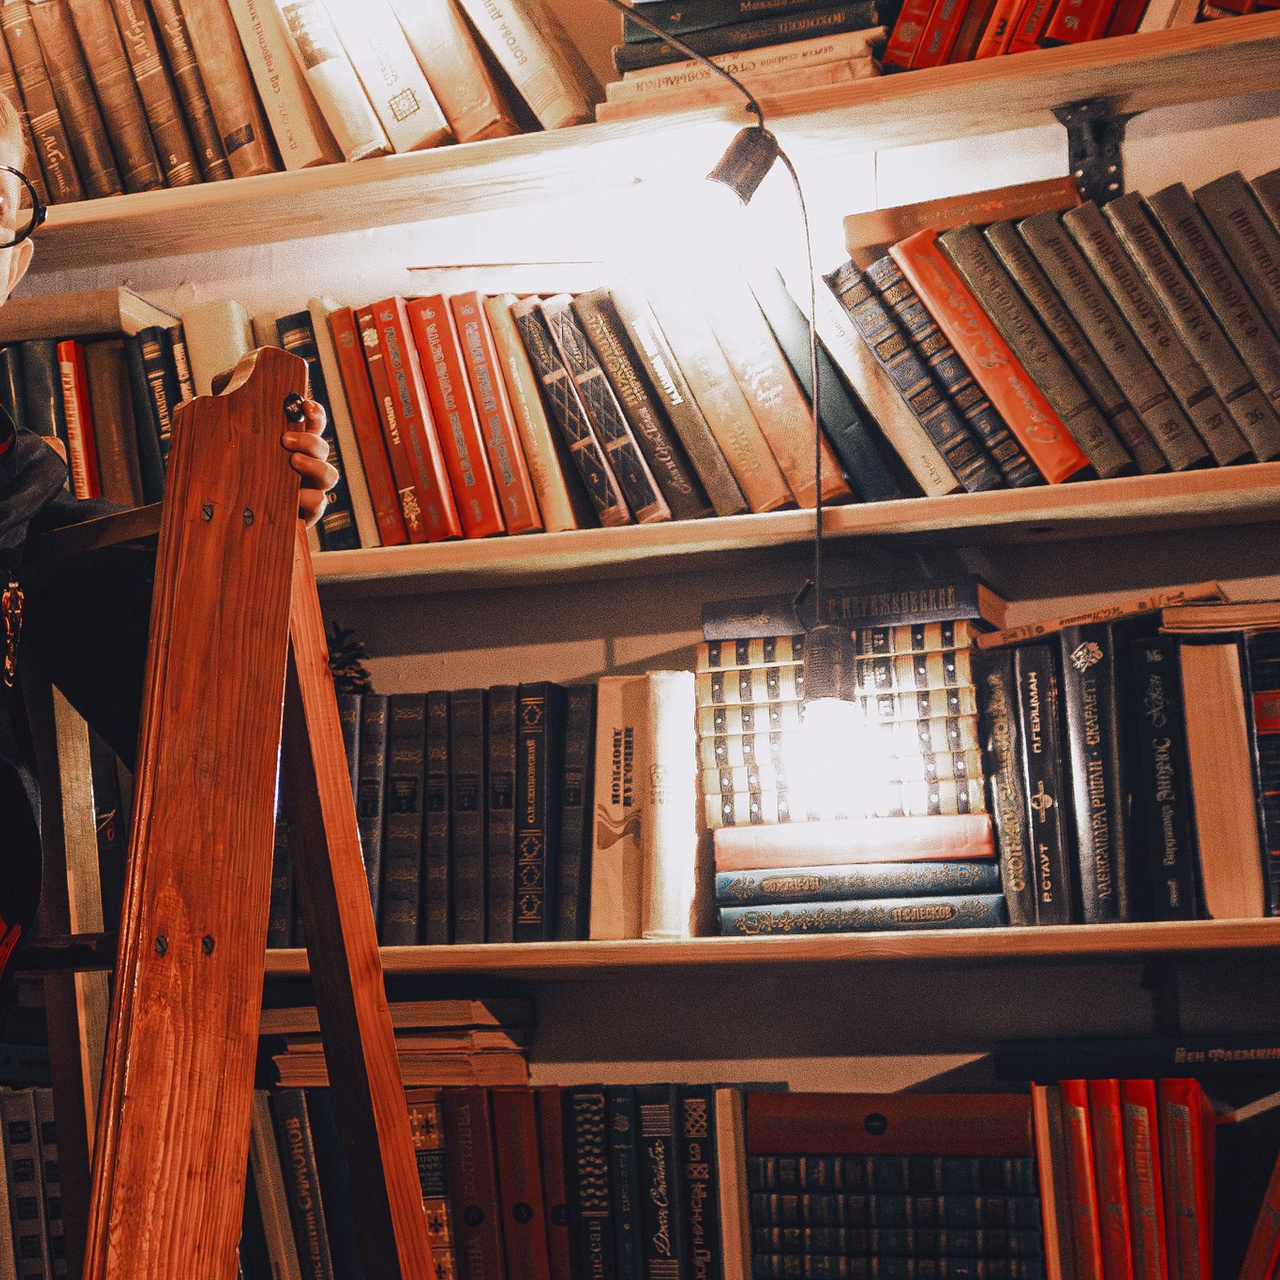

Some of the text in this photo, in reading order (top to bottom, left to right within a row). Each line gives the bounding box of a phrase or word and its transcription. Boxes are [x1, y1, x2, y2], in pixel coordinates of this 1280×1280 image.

[498, 20, 529, 67] БОГОВА
[1007, 373, 1063, 453] Семен
[1080, 677, 1102, 747] СКАРЛЕТТ
[610, 726, 622, 805] ДВОРЦОВ
[622, 725, 634, 807] НИКОЛАЙ
[1039, 843, 1053, 903] Р.СТАУТ
[1092, 809, 1114, 900] АЛЕКСАНДРА
[288, 1115, 313, 1210] СИМОНОВ
